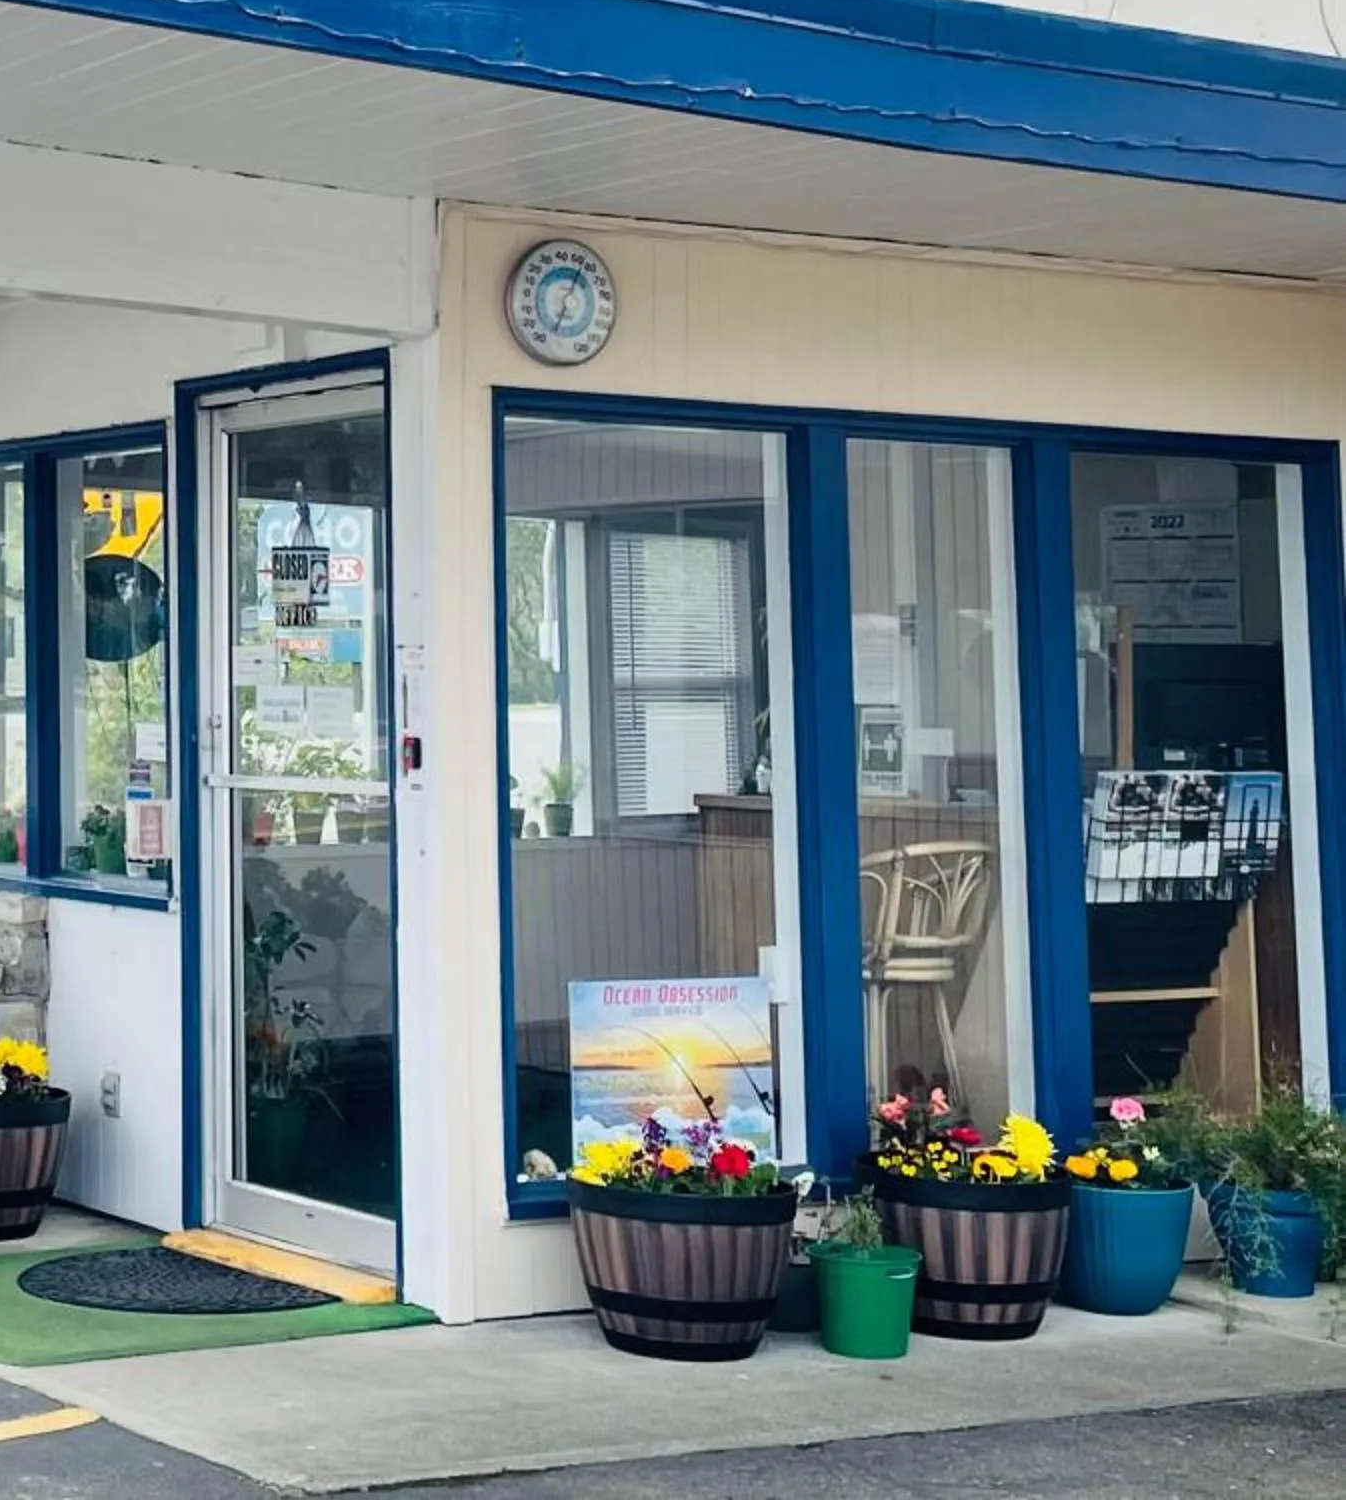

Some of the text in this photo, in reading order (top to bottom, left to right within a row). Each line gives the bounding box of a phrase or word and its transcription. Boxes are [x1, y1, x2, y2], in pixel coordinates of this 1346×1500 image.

[272, 553, 309, 581] CLOSED
[603, 983, 738, 1006] OCEAN OBSESSION
